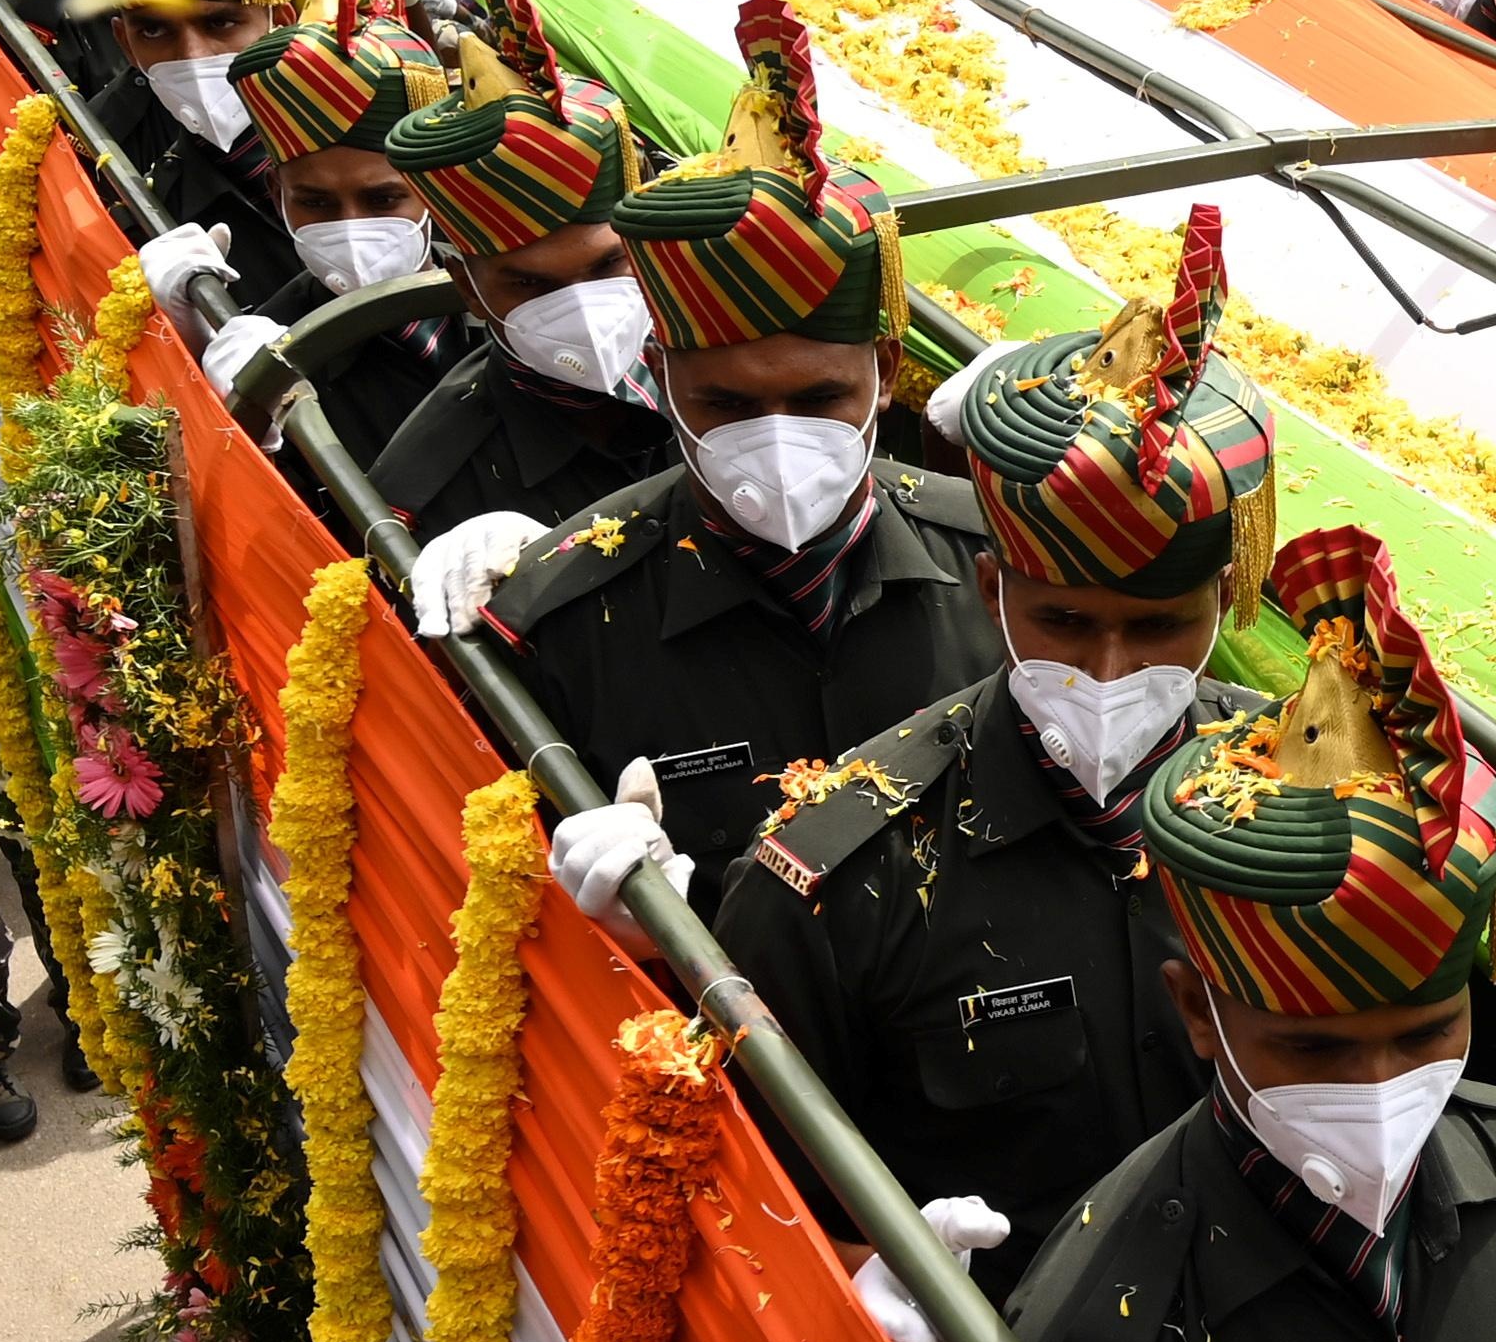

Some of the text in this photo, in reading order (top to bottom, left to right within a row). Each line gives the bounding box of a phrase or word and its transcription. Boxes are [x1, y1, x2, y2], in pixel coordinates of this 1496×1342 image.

[714, 759, 744, 771] KUMAR
[758, 843, 811, 896] BIHAR
[987, 1000, 1051, 1020] VIKAS KUMAR
